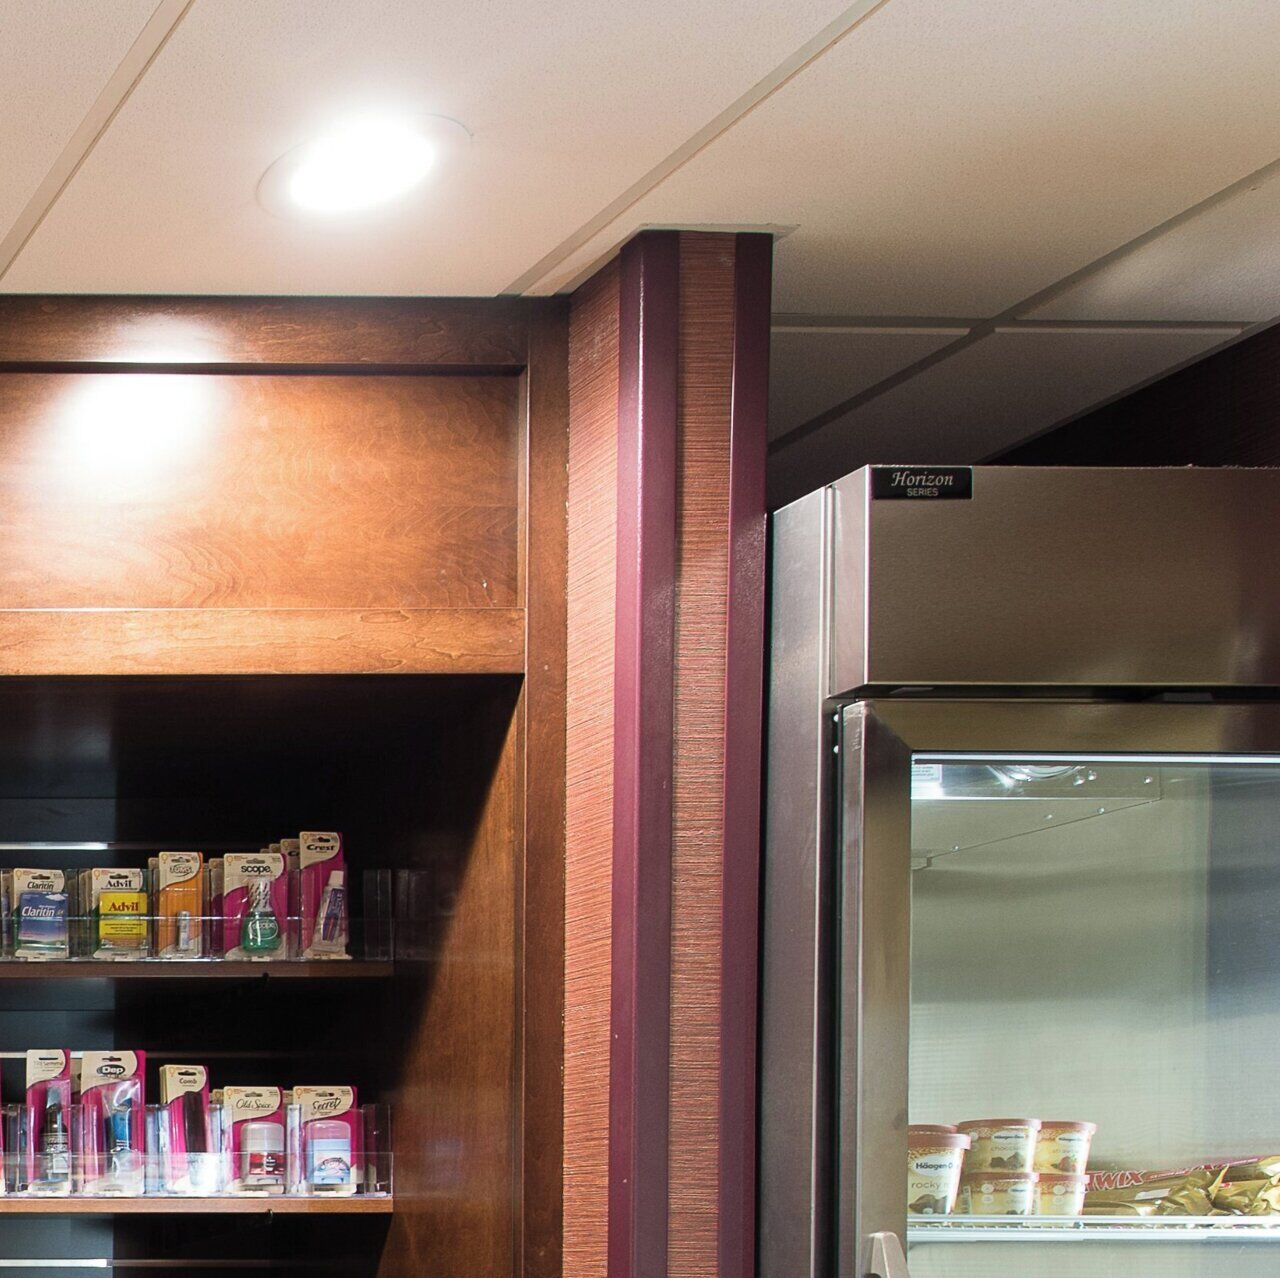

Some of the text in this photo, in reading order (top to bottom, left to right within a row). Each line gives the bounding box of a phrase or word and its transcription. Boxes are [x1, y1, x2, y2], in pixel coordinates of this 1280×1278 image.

[891, 471, 954, 486] Horizon
[906, 487, 939, 497] SERIES
[241, 864, 272, 874] scope
[27, 881, 55, 889] Claritin
[105, 880, 132, 888] Advil
[21, 905, 55, 917] Claritin
[108, 902, 139, 912] Advil
[101, 1065, 124, 1075] Dep
[236, 1098, 274, 1110] Old Spice
[311, 1097, 342, 1114] Secret
[911, 1182, 939, 1190] rocky
